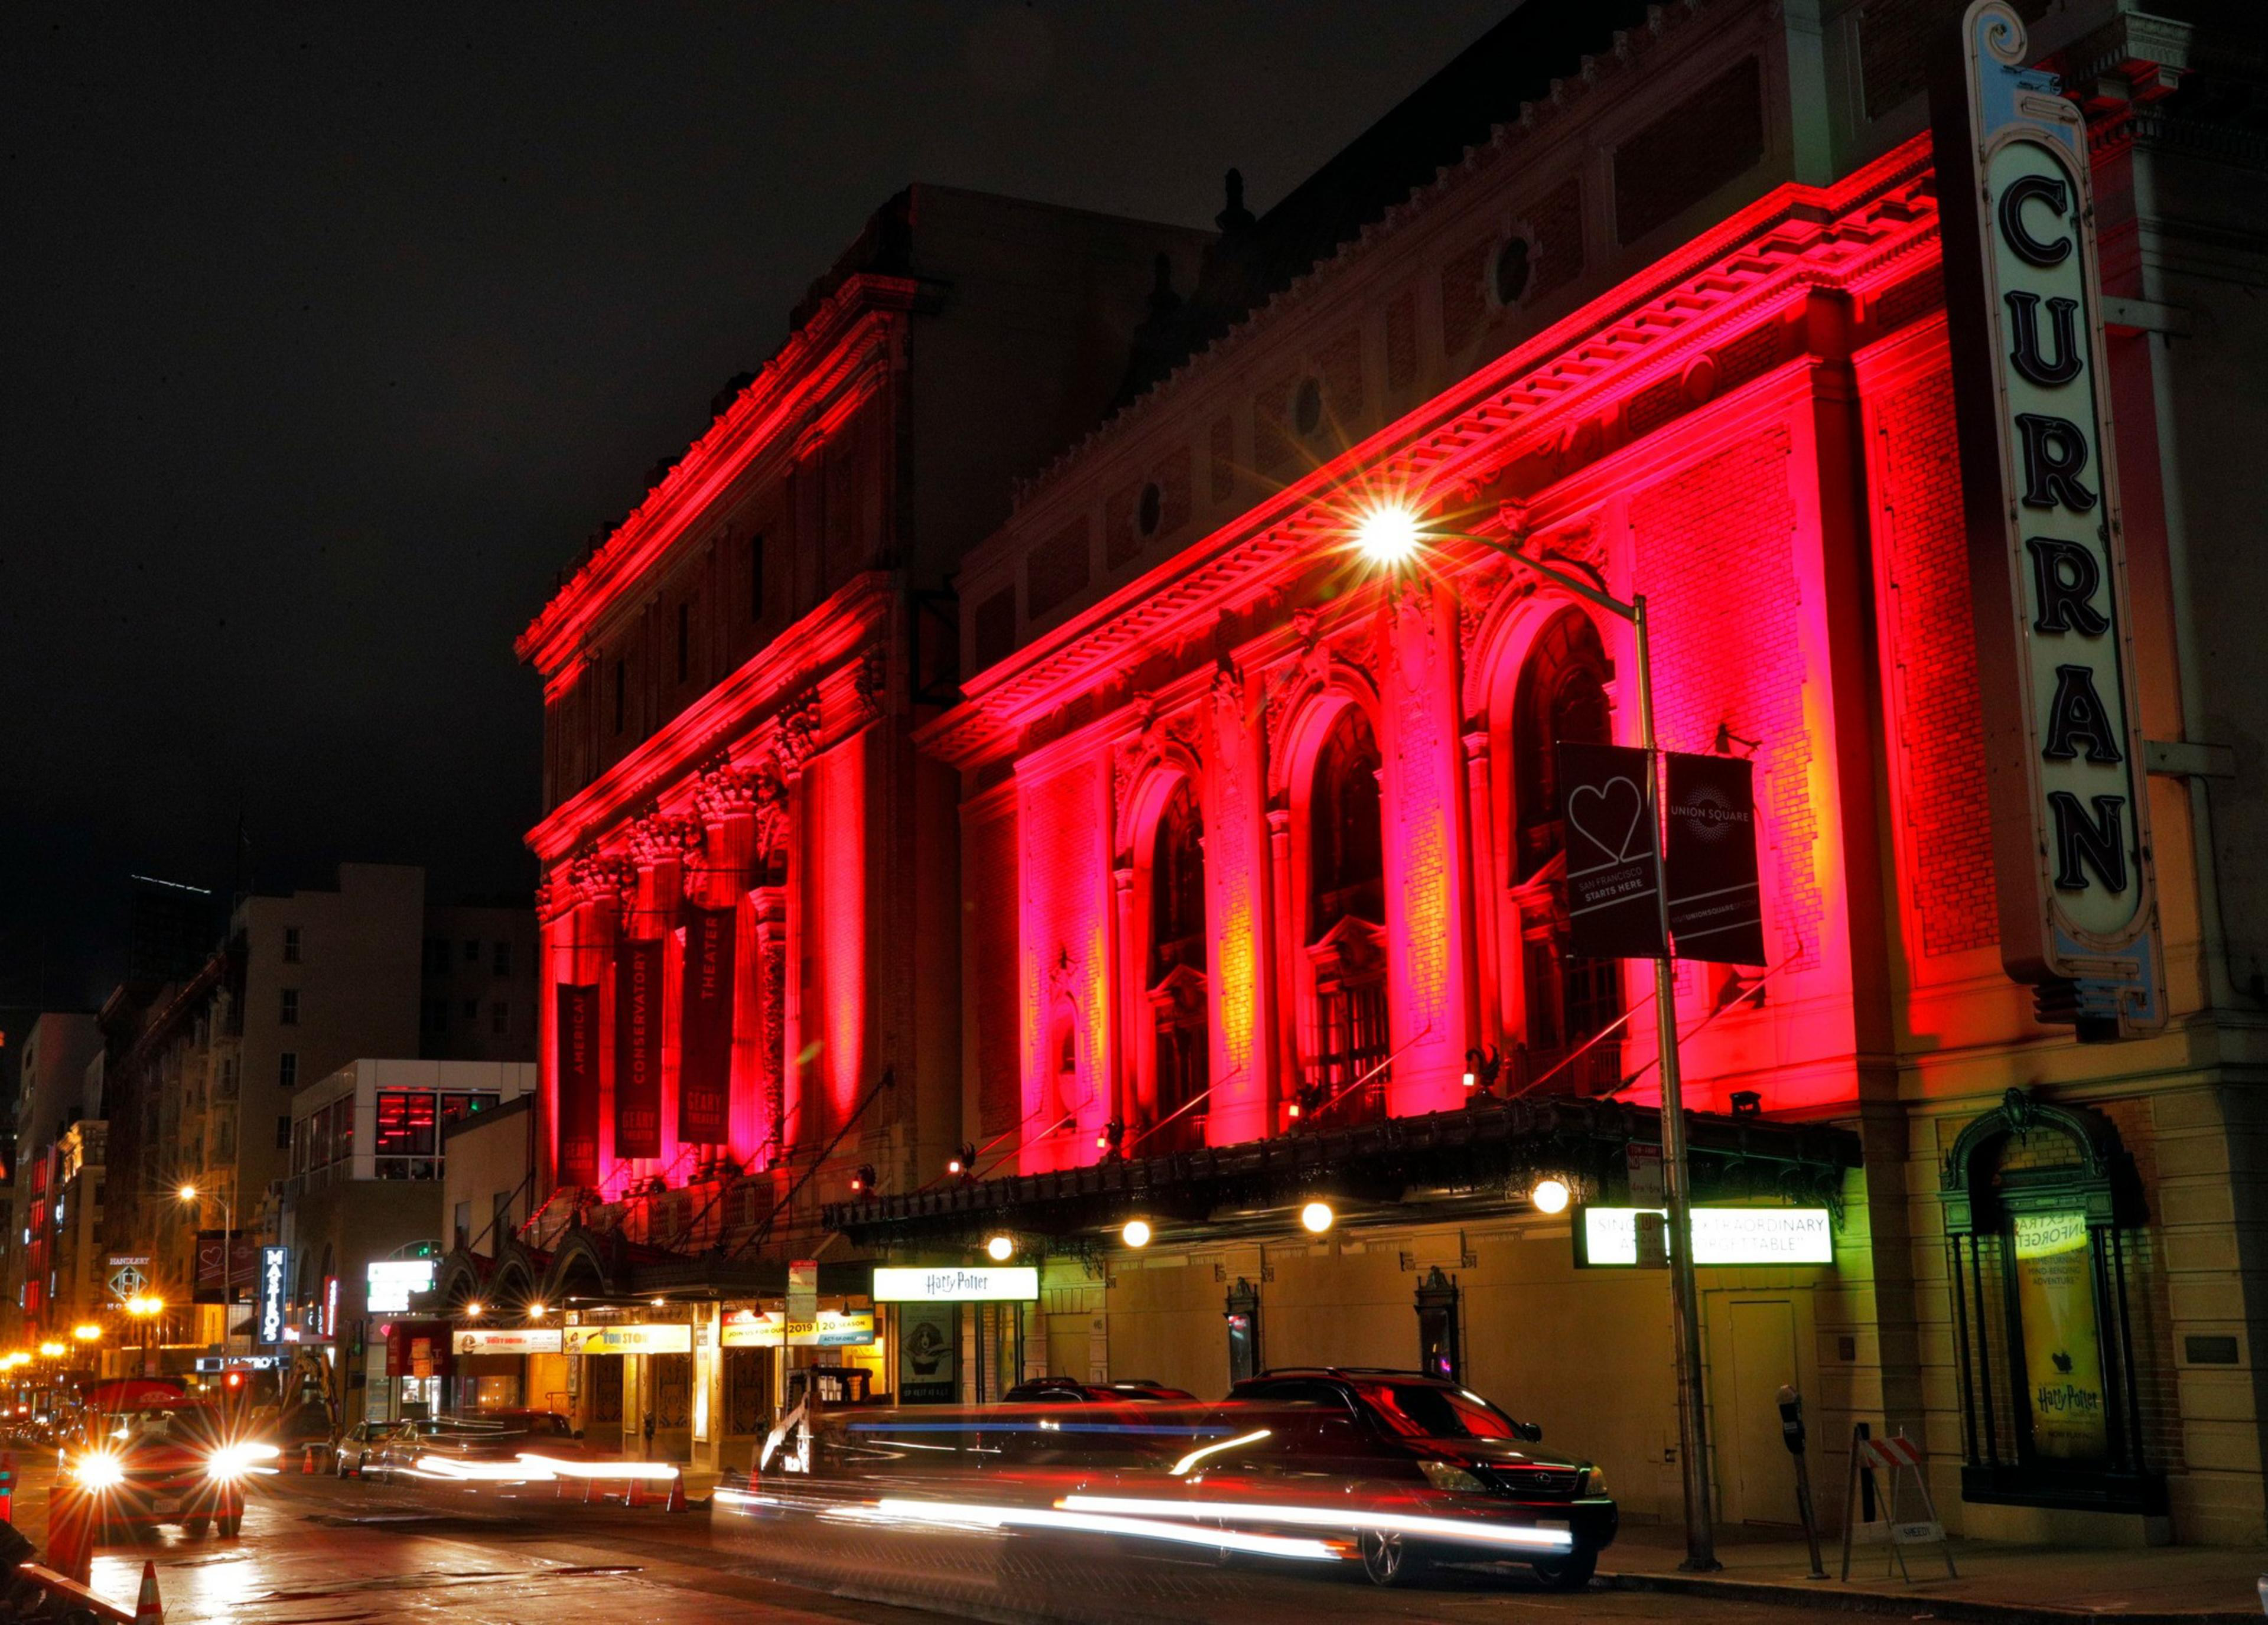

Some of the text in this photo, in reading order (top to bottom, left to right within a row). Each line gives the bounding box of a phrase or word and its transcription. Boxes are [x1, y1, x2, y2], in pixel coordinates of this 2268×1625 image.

[1999, 174, 2127, 893] CURRAN
[1671, 805, 1749, 822] UNION SQUARE
[1579, 866, 1642, 893] SAN FRANCISCO
[1584, 878, 1644, 903] STARTS HERE
[701, 917, 718, 1000] THEATER
[633, 950, 647, 1085] CONSERVATORY
[687, 1091, 721, 1111] GEARY
[623, 1111, 654, 1128] GEARY
[926, 1271, 988, 1295] Harry Potter
[789, 1323, 813, 1333] 2019
[822, 1322, 835, 1330] 20
[2038, 1384, 2097, 1413] Harry Potter
